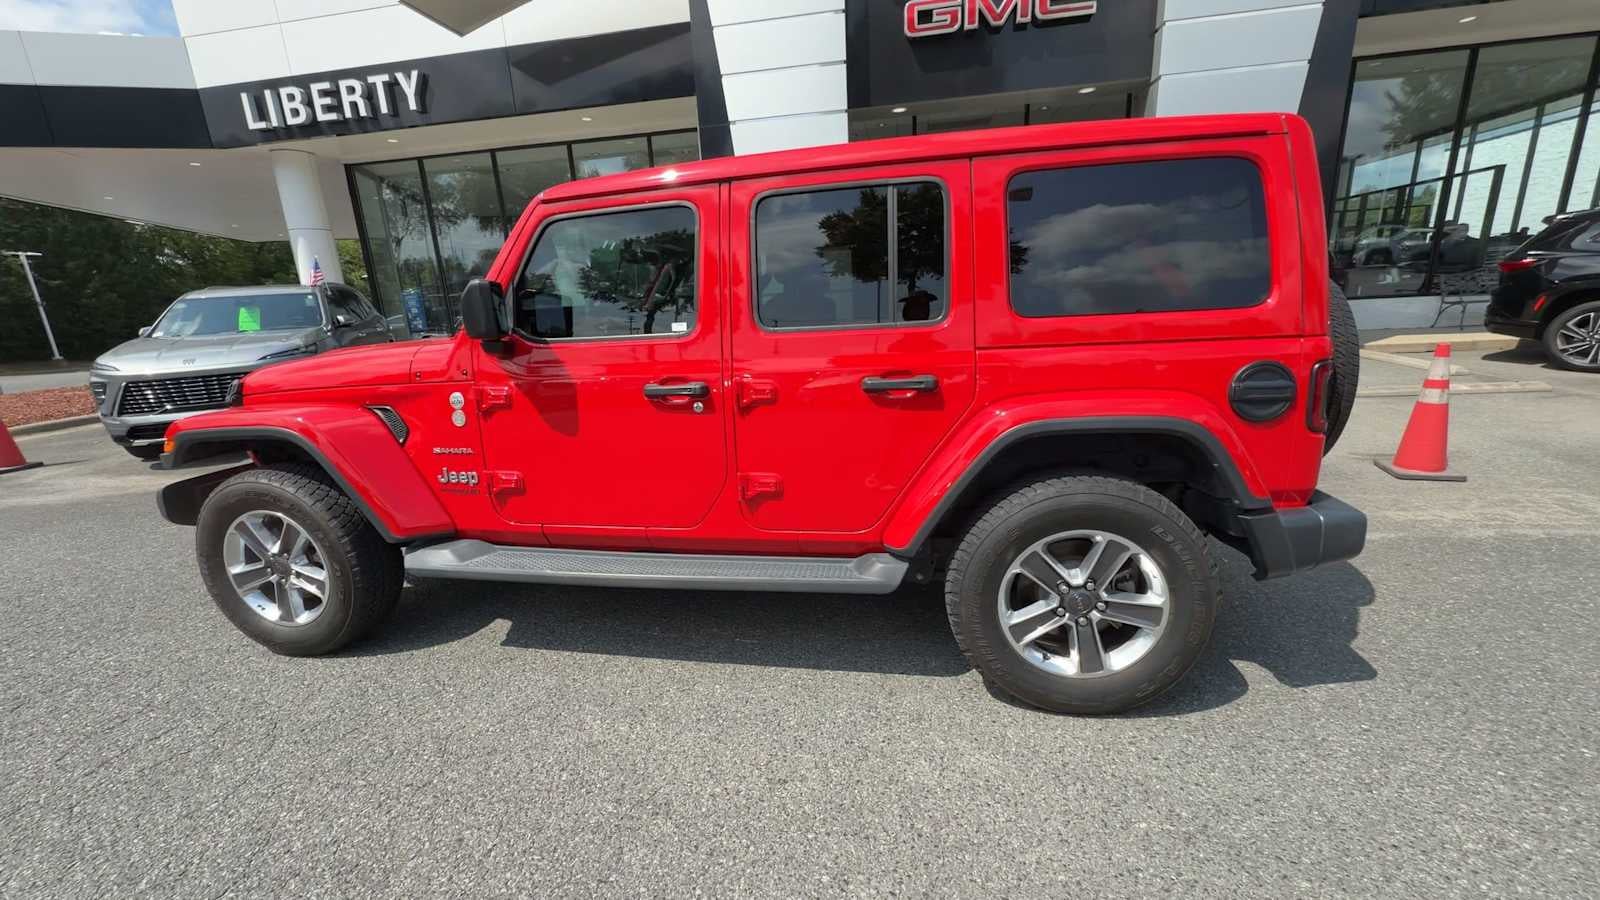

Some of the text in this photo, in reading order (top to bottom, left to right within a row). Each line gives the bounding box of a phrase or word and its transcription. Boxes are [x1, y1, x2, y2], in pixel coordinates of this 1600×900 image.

[904, 0, 1098, 38] GMC
[240, 69, 420, 131] LIBERTY
[437, 466, 479, 487] Jeep
